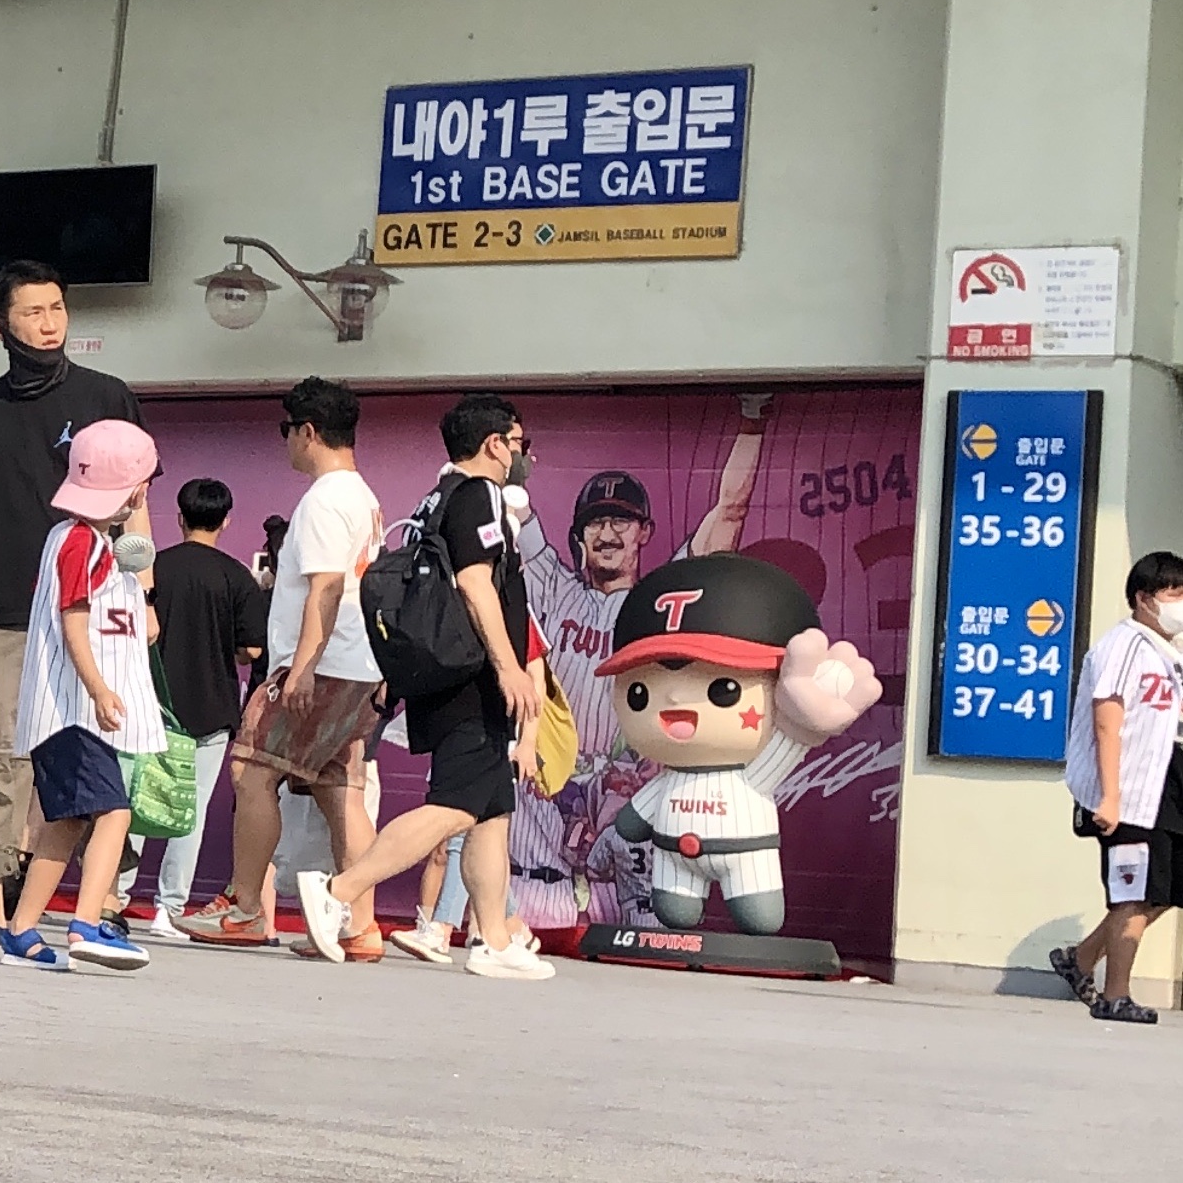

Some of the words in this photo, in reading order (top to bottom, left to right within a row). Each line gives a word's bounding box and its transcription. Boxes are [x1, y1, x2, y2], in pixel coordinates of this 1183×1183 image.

[391, 95, 568, 161] 내야1루
[582, 85, 735, 155] 출입문
[411, 170, 463, 204] 1st
[482, 163, 582, 201] BASE
[601, 158, 707, 198] GATE
[383, 222, 459, 251] GATE
[474, 220, 522, 247] 2-3
[557, 229, 600, 242] JAMSIL
[606, 227, 665, 242] BASEBALL
[672, 226, 727, 240] STADIUM
[952, 345, 970, 357] NO
[973, 344, 1029, 357] SMOKING
[1015, 454, 1046, 466] GATE
[598, 477, 625, 498] T
[799, 453, 913, 519] 2504
[958, 514, 1065, 548] 35-36
[655, 588, 704, 633] T
[560, 618, 610, 660] TWI
[960, 622, 990, 636] GATE
[954, 642, 1062, 677] 30-34
[952, 686, 1055, 721] 37-41
[669, 798, 728, 816] TWINS
[629, 847, 655, 875] 3
[613, 929, 636, 946] LG
[638, 931, 704, 952] TWINS
